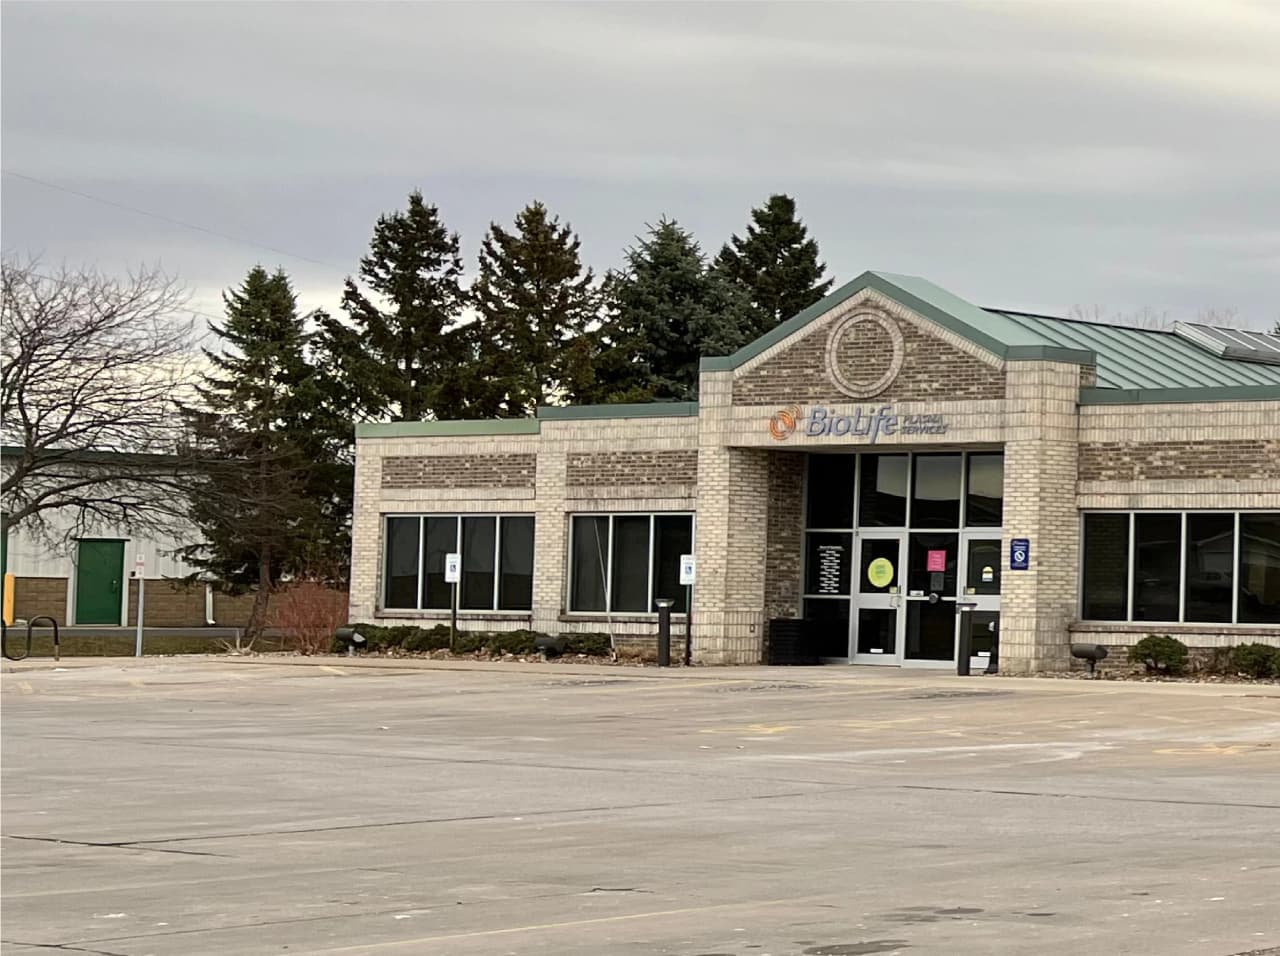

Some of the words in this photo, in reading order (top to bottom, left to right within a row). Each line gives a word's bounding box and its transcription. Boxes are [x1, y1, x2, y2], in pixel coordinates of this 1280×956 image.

[806, 406, 898, 444] BioLife
[903, 415, 943, 426] PLASMA
[900, 424, 949, 435] SERVICES
